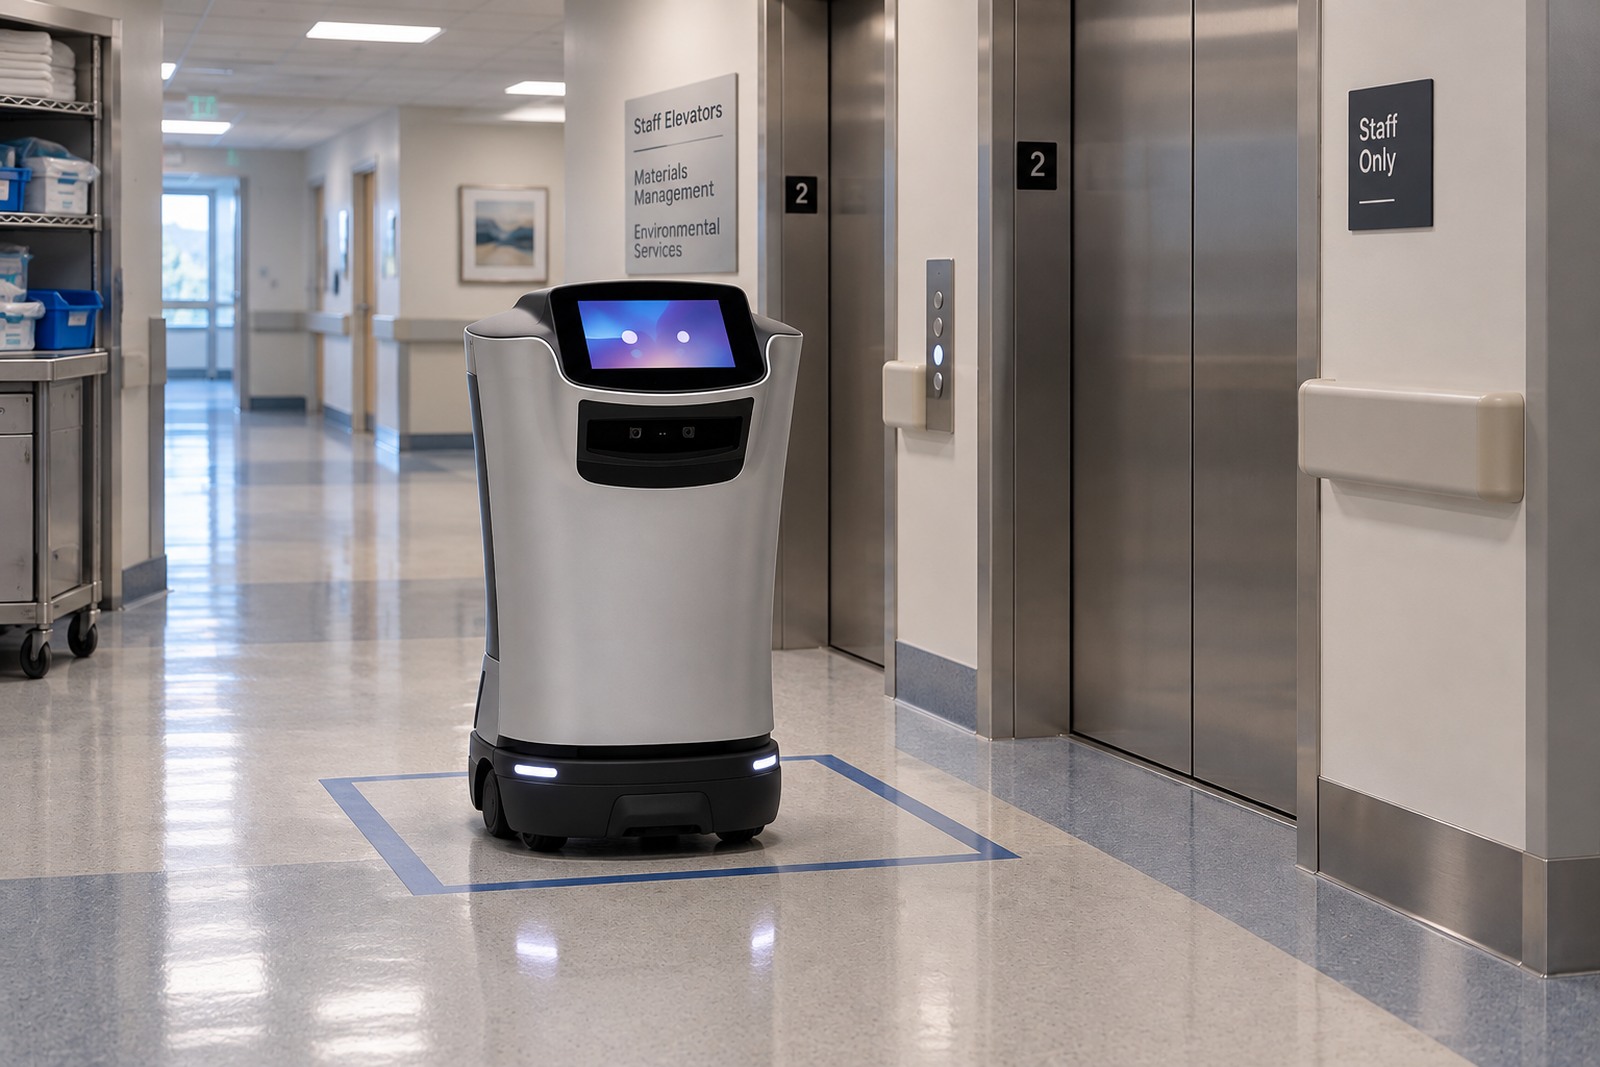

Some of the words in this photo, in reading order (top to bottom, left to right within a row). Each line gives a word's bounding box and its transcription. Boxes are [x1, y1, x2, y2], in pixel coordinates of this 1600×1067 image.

[634, 112, 661, 135] Staff
[665, 104, 723, 129] Elevators
[1359, 112, 1398, 142] Staff
[634, 162, 688, 186] Materials
[1030, 151, 1045, 177] 2
[1359, 146, 1397, 177] Only
[634, 181, 715, 206] Management
[796, 182, 808, 204] 2
[634, 217, 720, 240] Environmental
[634, 241, 682, 259] Services
